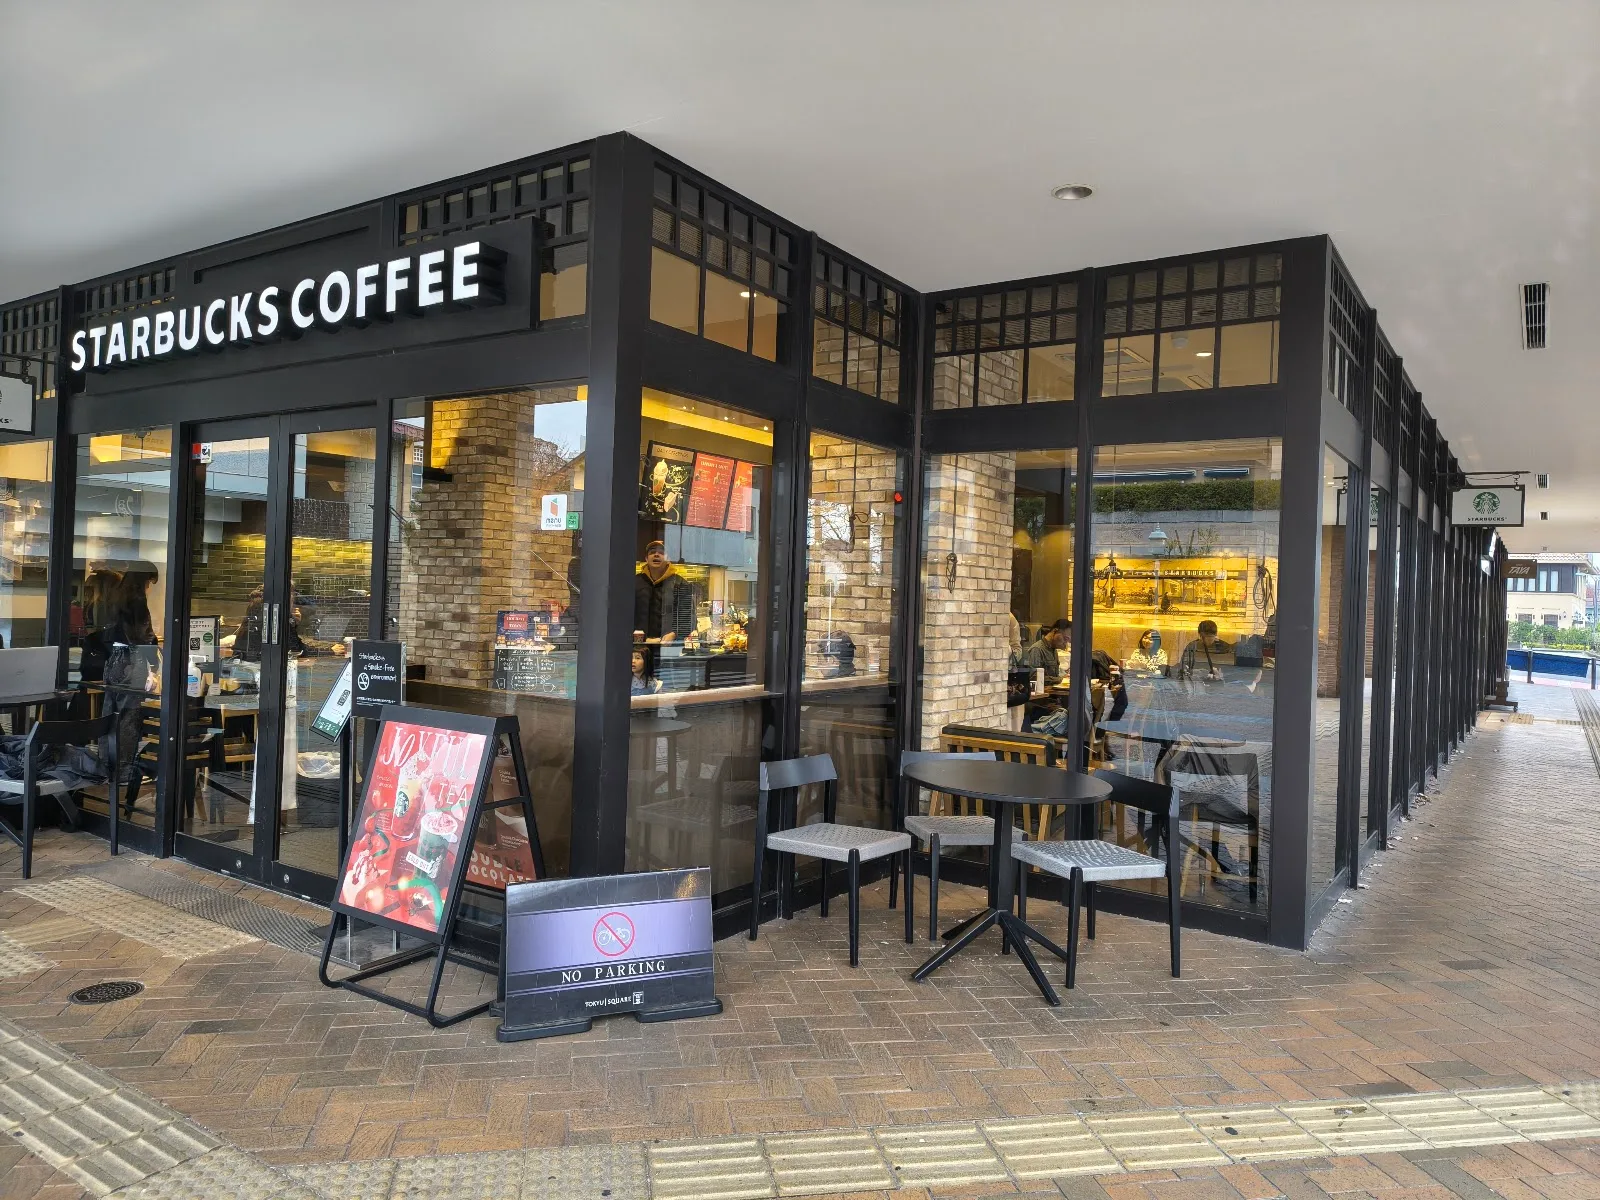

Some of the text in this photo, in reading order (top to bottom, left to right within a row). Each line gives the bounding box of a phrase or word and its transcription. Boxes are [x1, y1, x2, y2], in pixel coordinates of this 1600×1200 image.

[70, 241, 483, 372] STARBUCKS COFFEE
[1508, 566, 1531, 575] TAYA
[383, 727, 473, 780] JOYFUL
[437, 782, 468, 808] TEA
[470, 849, 524, 872] OUBLE
[561, 960, 666, 984] NO PARKING
[584, 999, 605, 1008] TOKYU
[607, 996, 632, 1005] SQUARE
